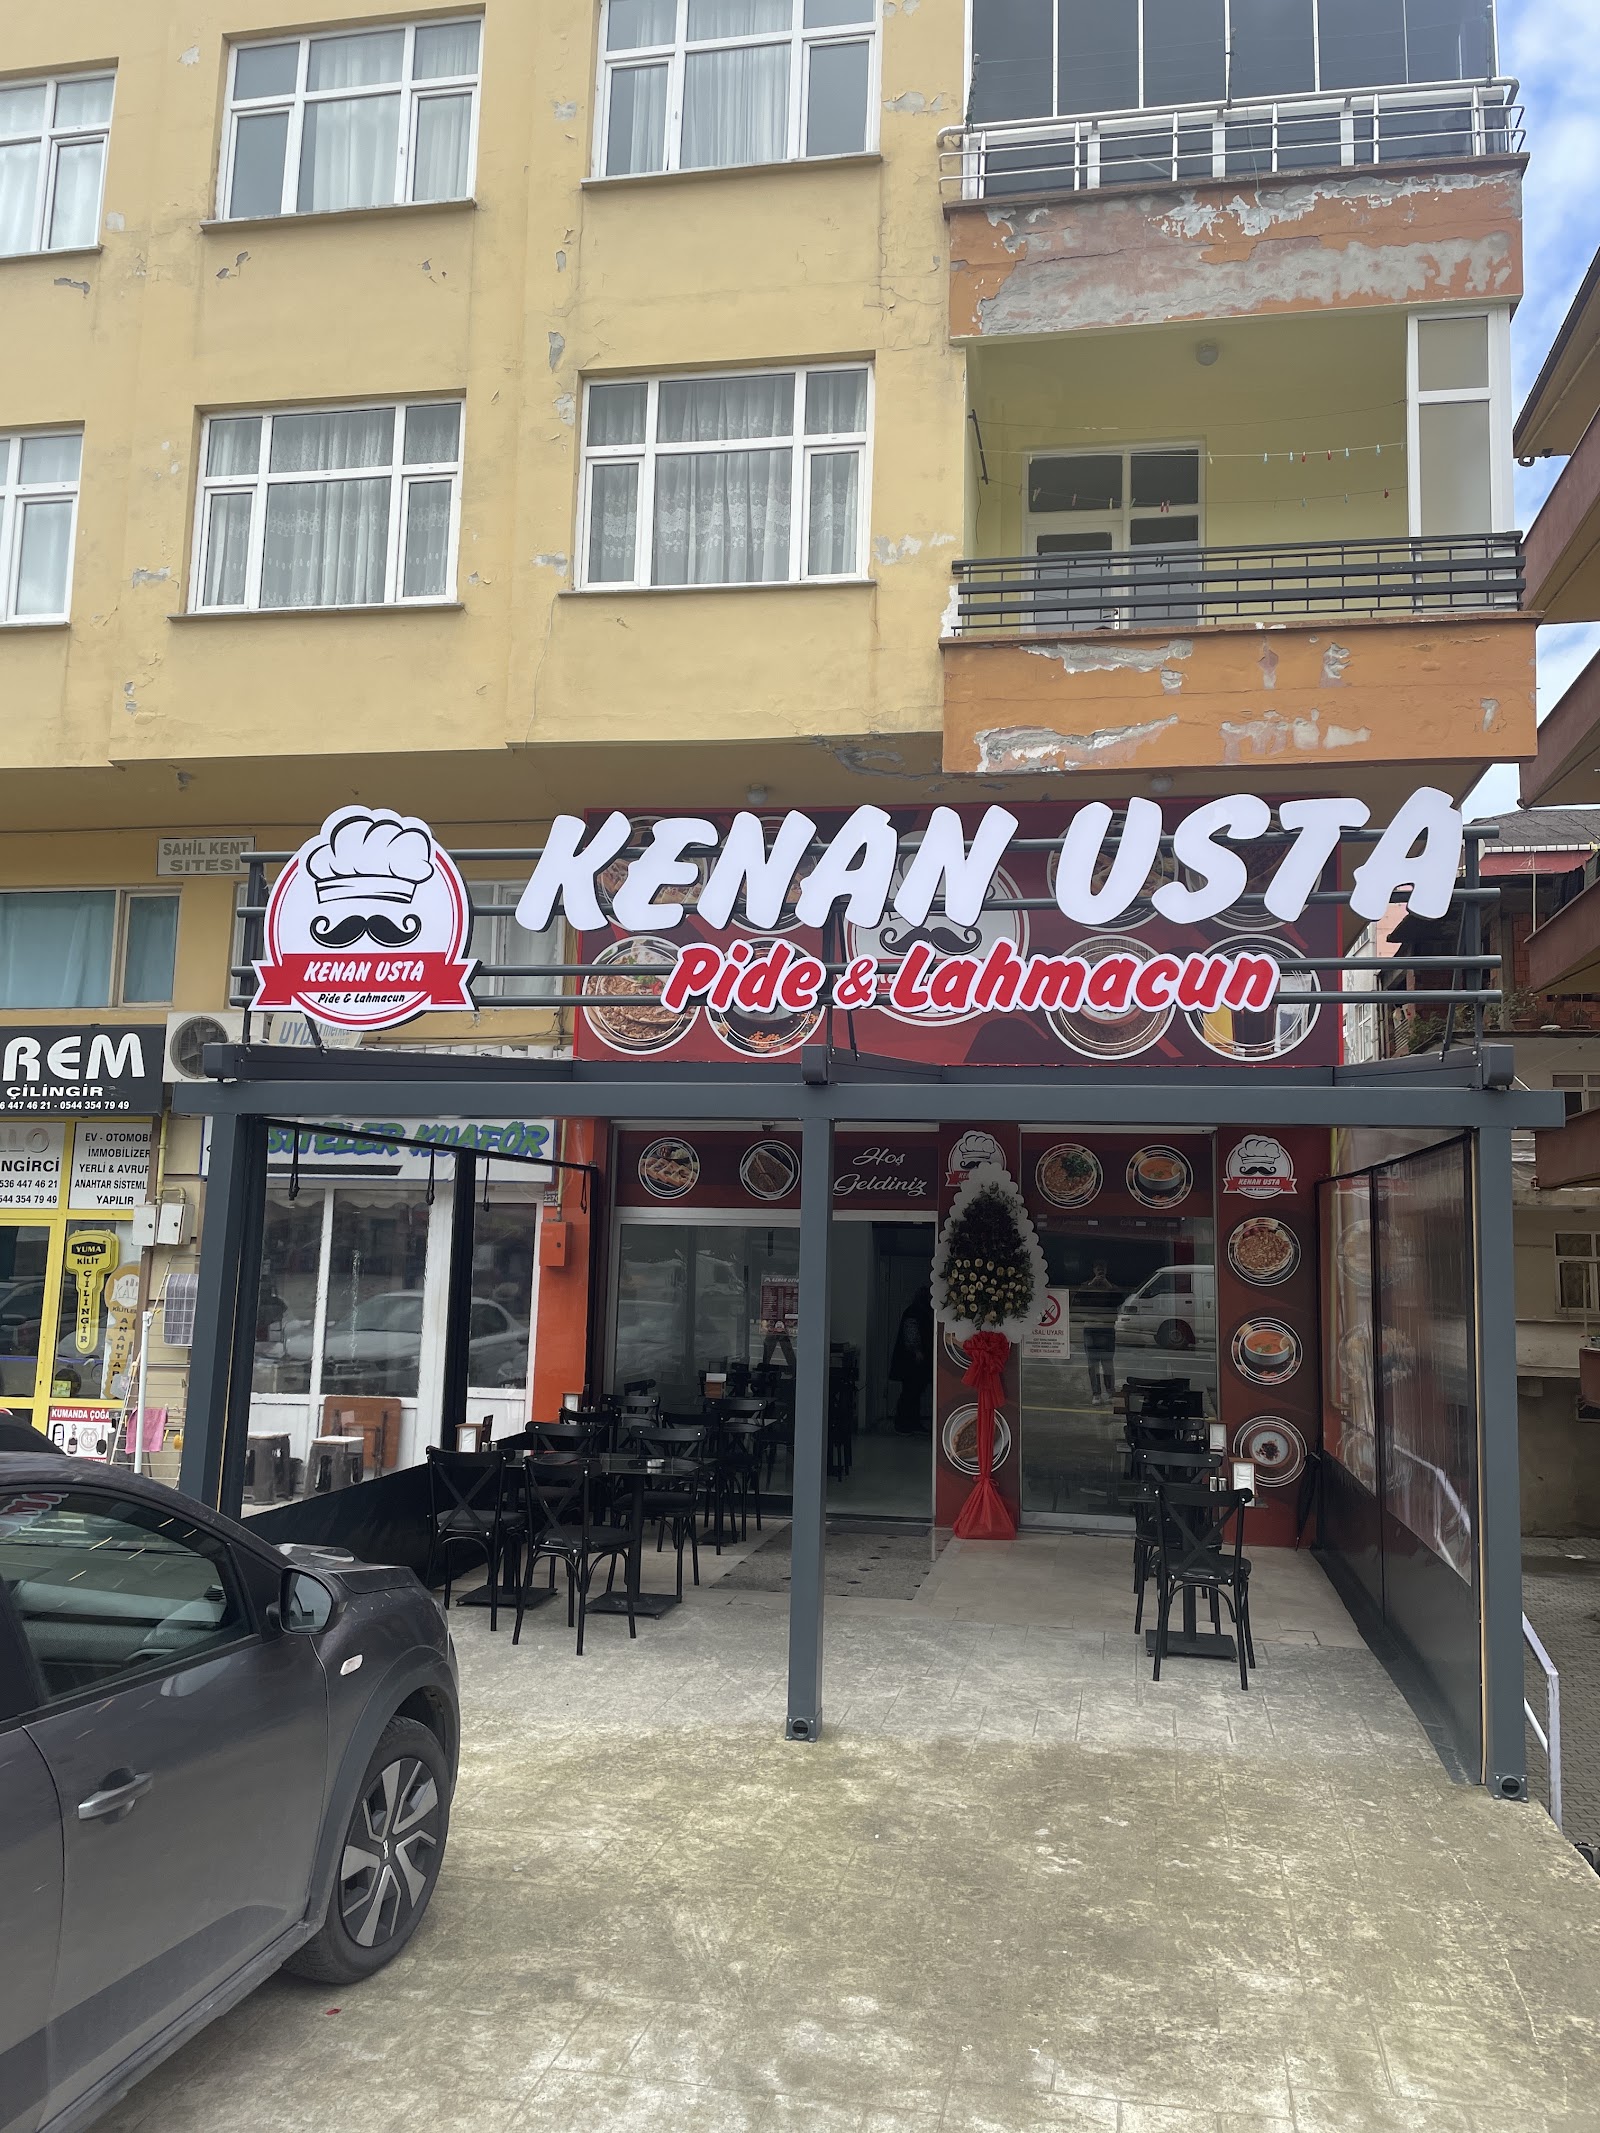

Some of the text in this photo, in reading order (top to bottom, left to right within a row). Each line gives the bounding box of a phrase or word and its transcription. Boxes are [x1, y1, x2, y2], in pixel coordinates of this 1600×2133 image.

[163, 840, 249, 856] SAHİL KENT
[515, 786, 1464, 930] KENAN USTA
[303, 959, 425, 982] KENAN USTA
[660, 935, 1281, 1014] Pide & Lahmacun
[317, 992, 405, 1004] Pide & Lahmacun
[2, 1032, 146, 1082] REM
[6, 1083, 104, 1100] ÇİLİNGİR
[8, 1101, 24, 1109] 447
[26, 1101, 38, 1109] 46
[40, 1101, 51, 1109] 21
[59, 1101, 82, 1110] 0544
[84, 1101, 102, 1110] 354
[104, 1101, 115, 1109] 79
[117, 1101, 130, 1109] 49
[85, 1133, 98, 1142] EV
[852, 1147, 906, 1166] Hoş
[1, 1157, 60, 1172] NGİRCİ
[79, 1161, 106, 1173] YERLİ
[108, 1164, 115, 1173] &
[16, 1179, 33, 1188] 447
[34, 1179, 46, 1188] 46
[47, 1179, 58, 1188] 21
[74, 1179, 112, 1190] ANAHTAR
[832, 1173, 928, 1197] Geldiniz
[1238, 1178, 1281, 1186] KENAN USTA
[15, 1194, 32, 1204] 354
[34, 1194, 45, 1204] 79
[46, 1194, 58, 1204] 49
[96, 1194, 134, 1205] YAPILIR
[75, 1245, 101, 1253] YUMA
[76, 1256, 99, 1265] KİLİT
[80, 1269, 92, 1343] ÇİLİNGİR
[51, 1408, 88, 1419] KUMANDA
